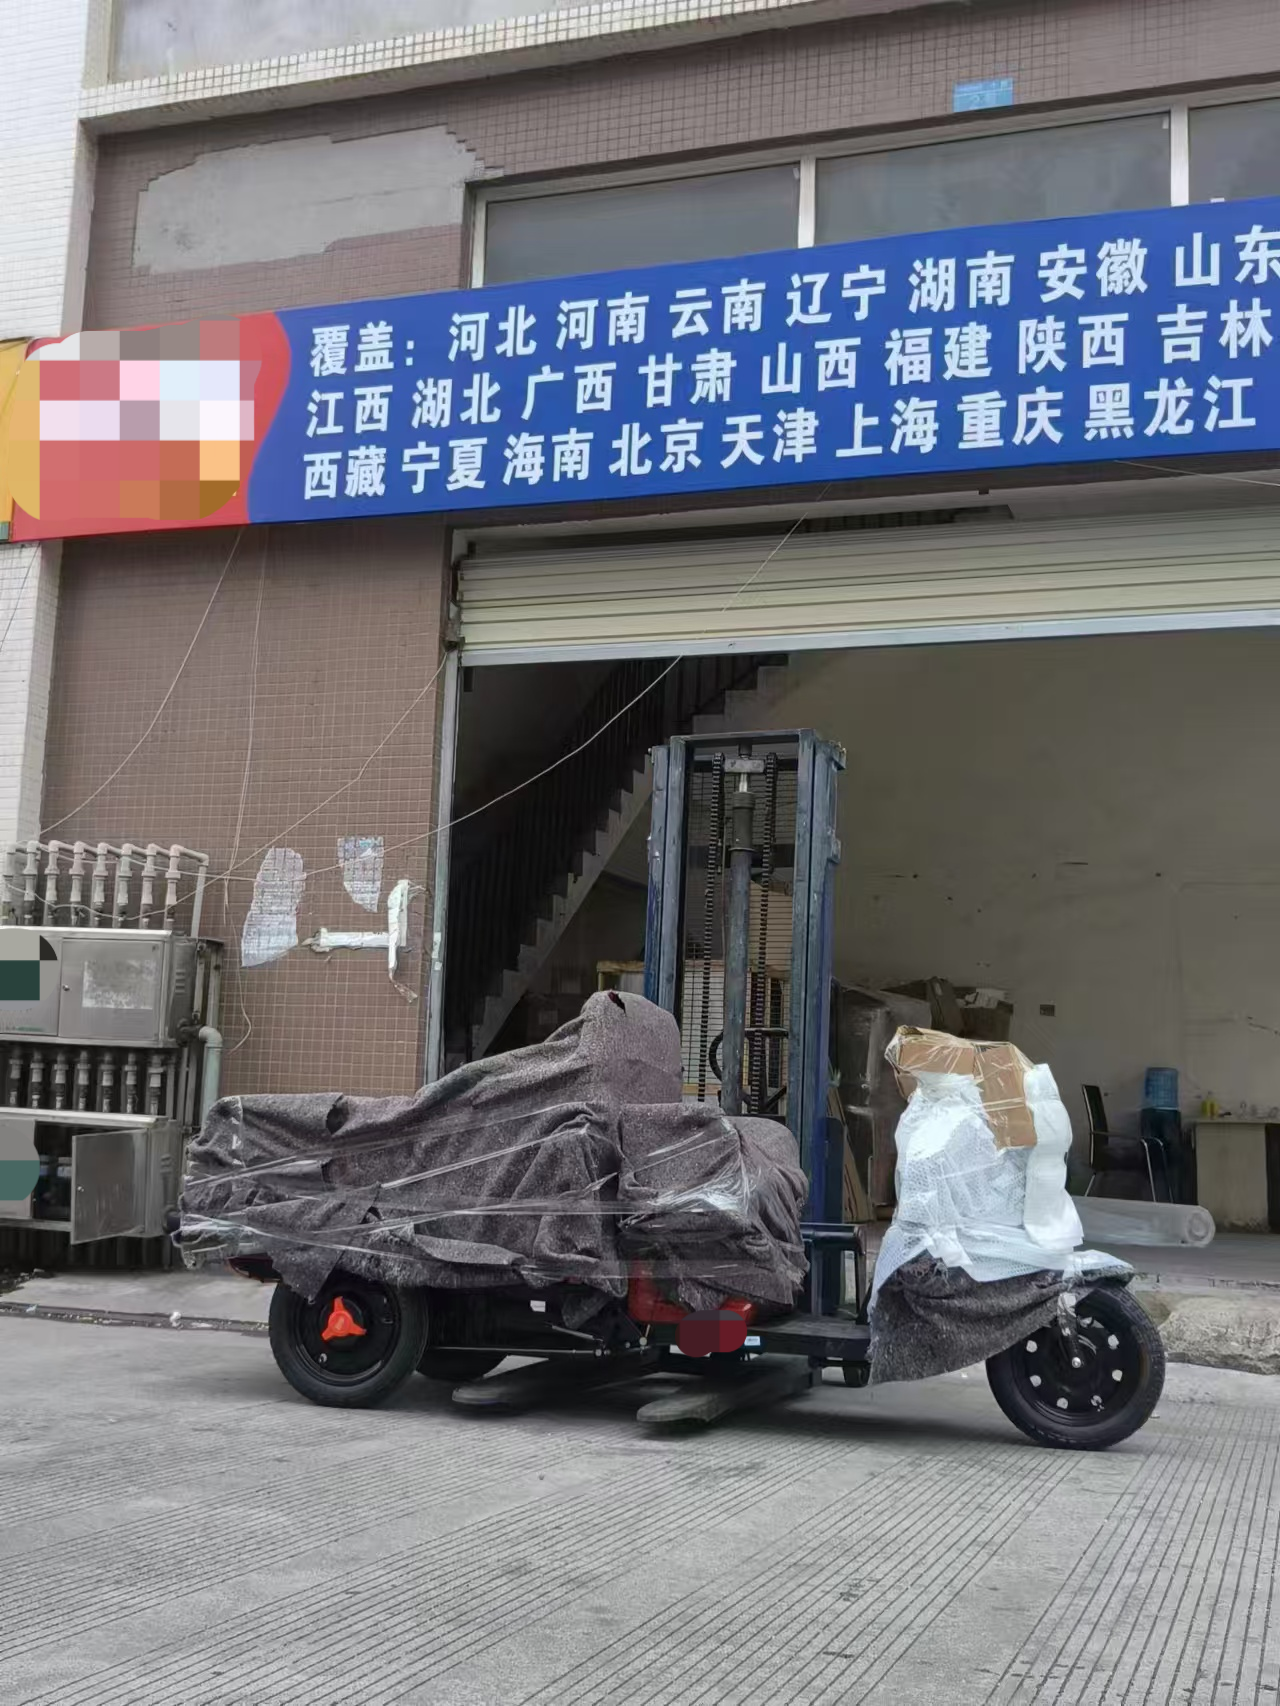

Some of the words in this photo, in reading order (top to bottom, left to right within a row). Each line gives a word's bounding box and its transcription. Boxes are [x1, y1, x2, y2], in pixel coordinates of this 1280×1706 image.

[448, 304, 537, 362] 河北
[556, 291, 650, 350] 河南
[669, 278, 766, 339] 云南
[785, 264, 886, 327] 辽宁
[908, 250, 1015, 313] 湖南
[1037, 238, 1148, 303] 安徽
[1175, 224, 1280, 287] 山东
[306, 384, 393, 438] 江西
[411, 372, 501, 429] 湖北
[521, 362, 617, 421] 广西
[638, 347, 737, 408] 甘肃
[761, 337, 861, 394] 山西
[884, 321, 992, 386] 福建
[1018, 312, 1129, 374] 陕西
[1157, 297, 1273, 364] 吉林
[303, 444, 387, 500] 西藏
[401, 437, 488, 494] 宁夏
[502, 427, 594, 486] 海南
[608, 417, 704, 477] 北京
[720, 407, 819, 469] 天津
[835, 396, 939, 458] 上海
[957, 385, 1064, 449] 重庆
[1084, 375, 1256, 441] 黑龙江
